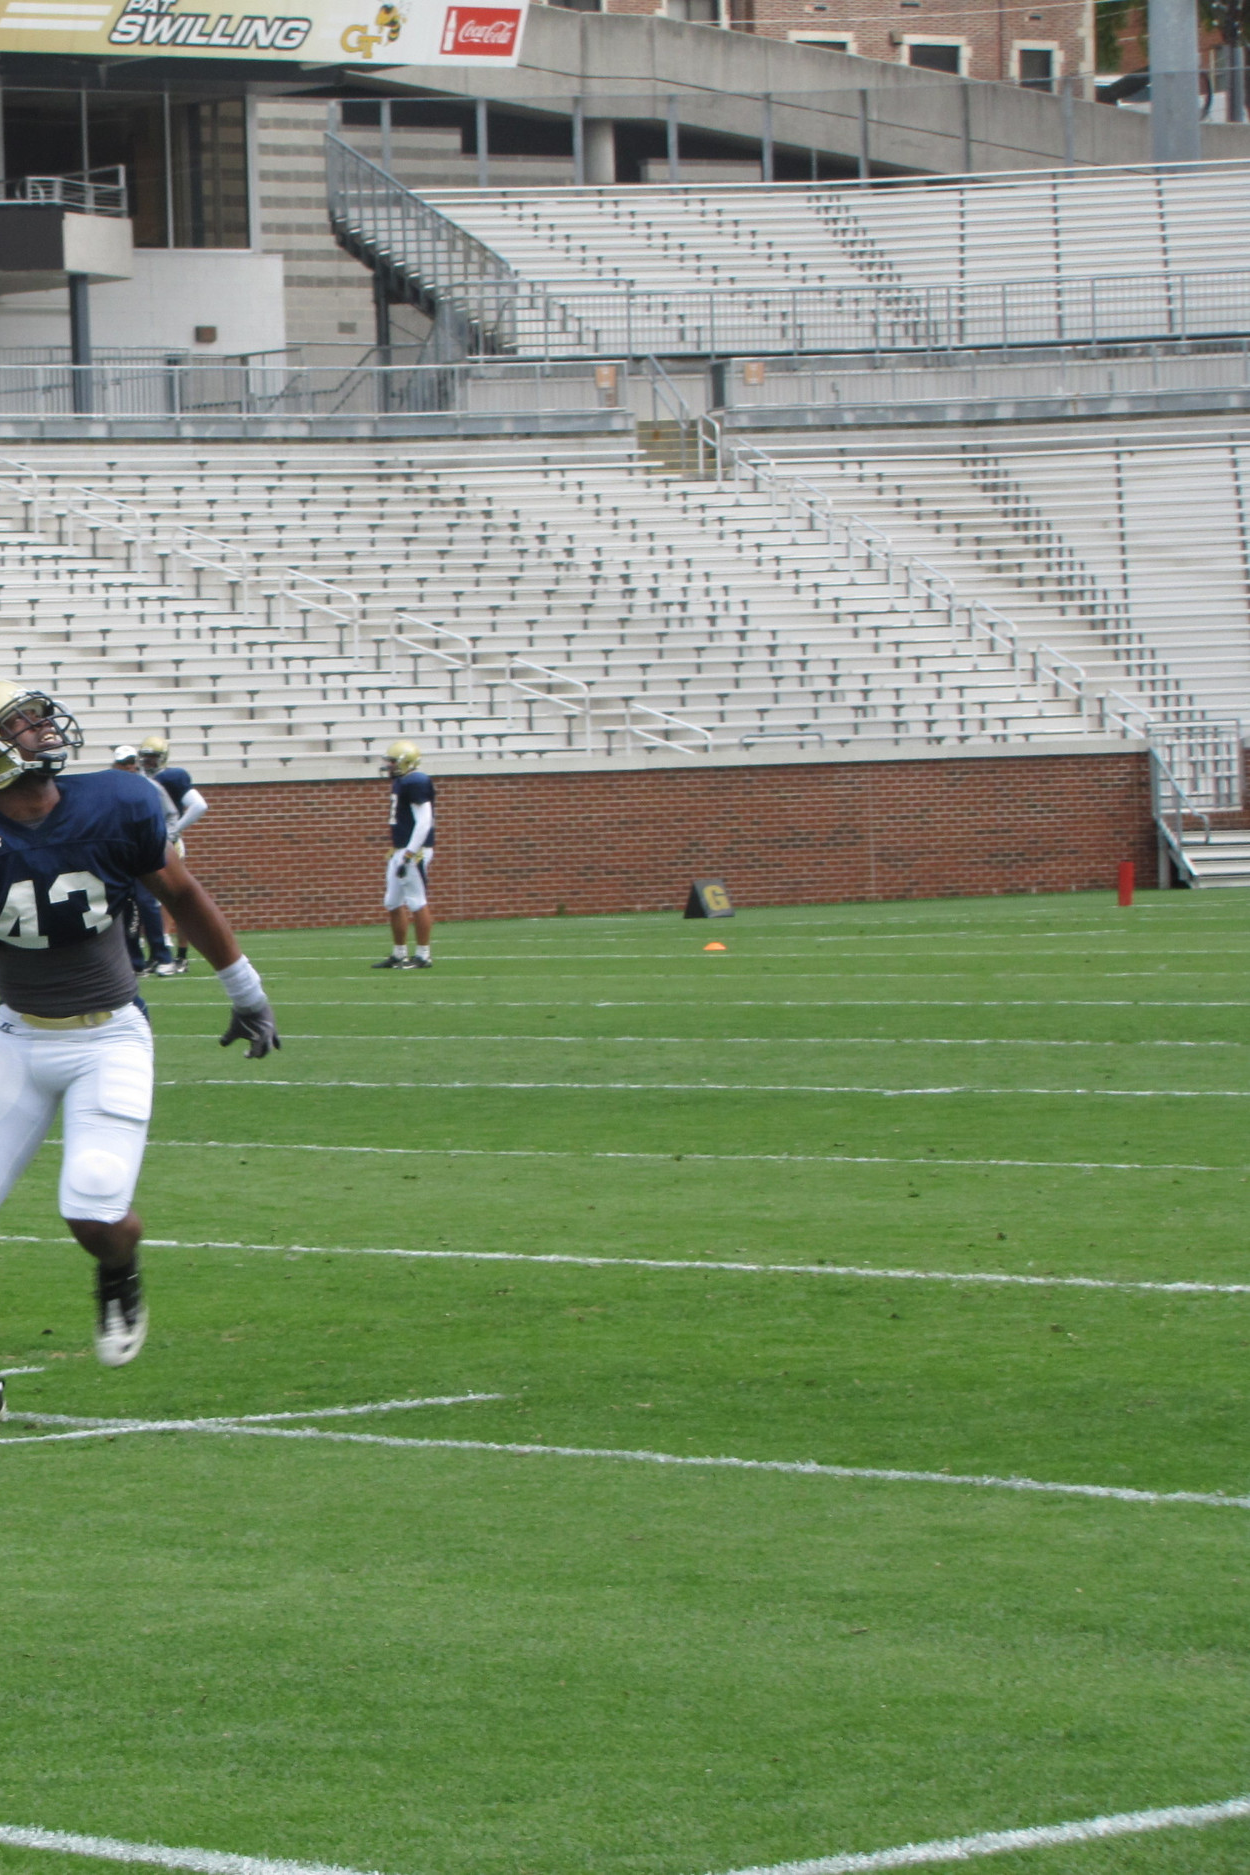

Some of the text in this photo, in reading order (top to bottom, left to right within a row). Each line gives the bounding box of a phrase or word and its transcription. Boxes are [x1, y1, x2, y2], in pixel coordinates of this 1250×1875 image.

[125, 0, 175, 13] PAT
[108, 13, 312, 49] SWILLING
[702, 884, 731, 911] G
